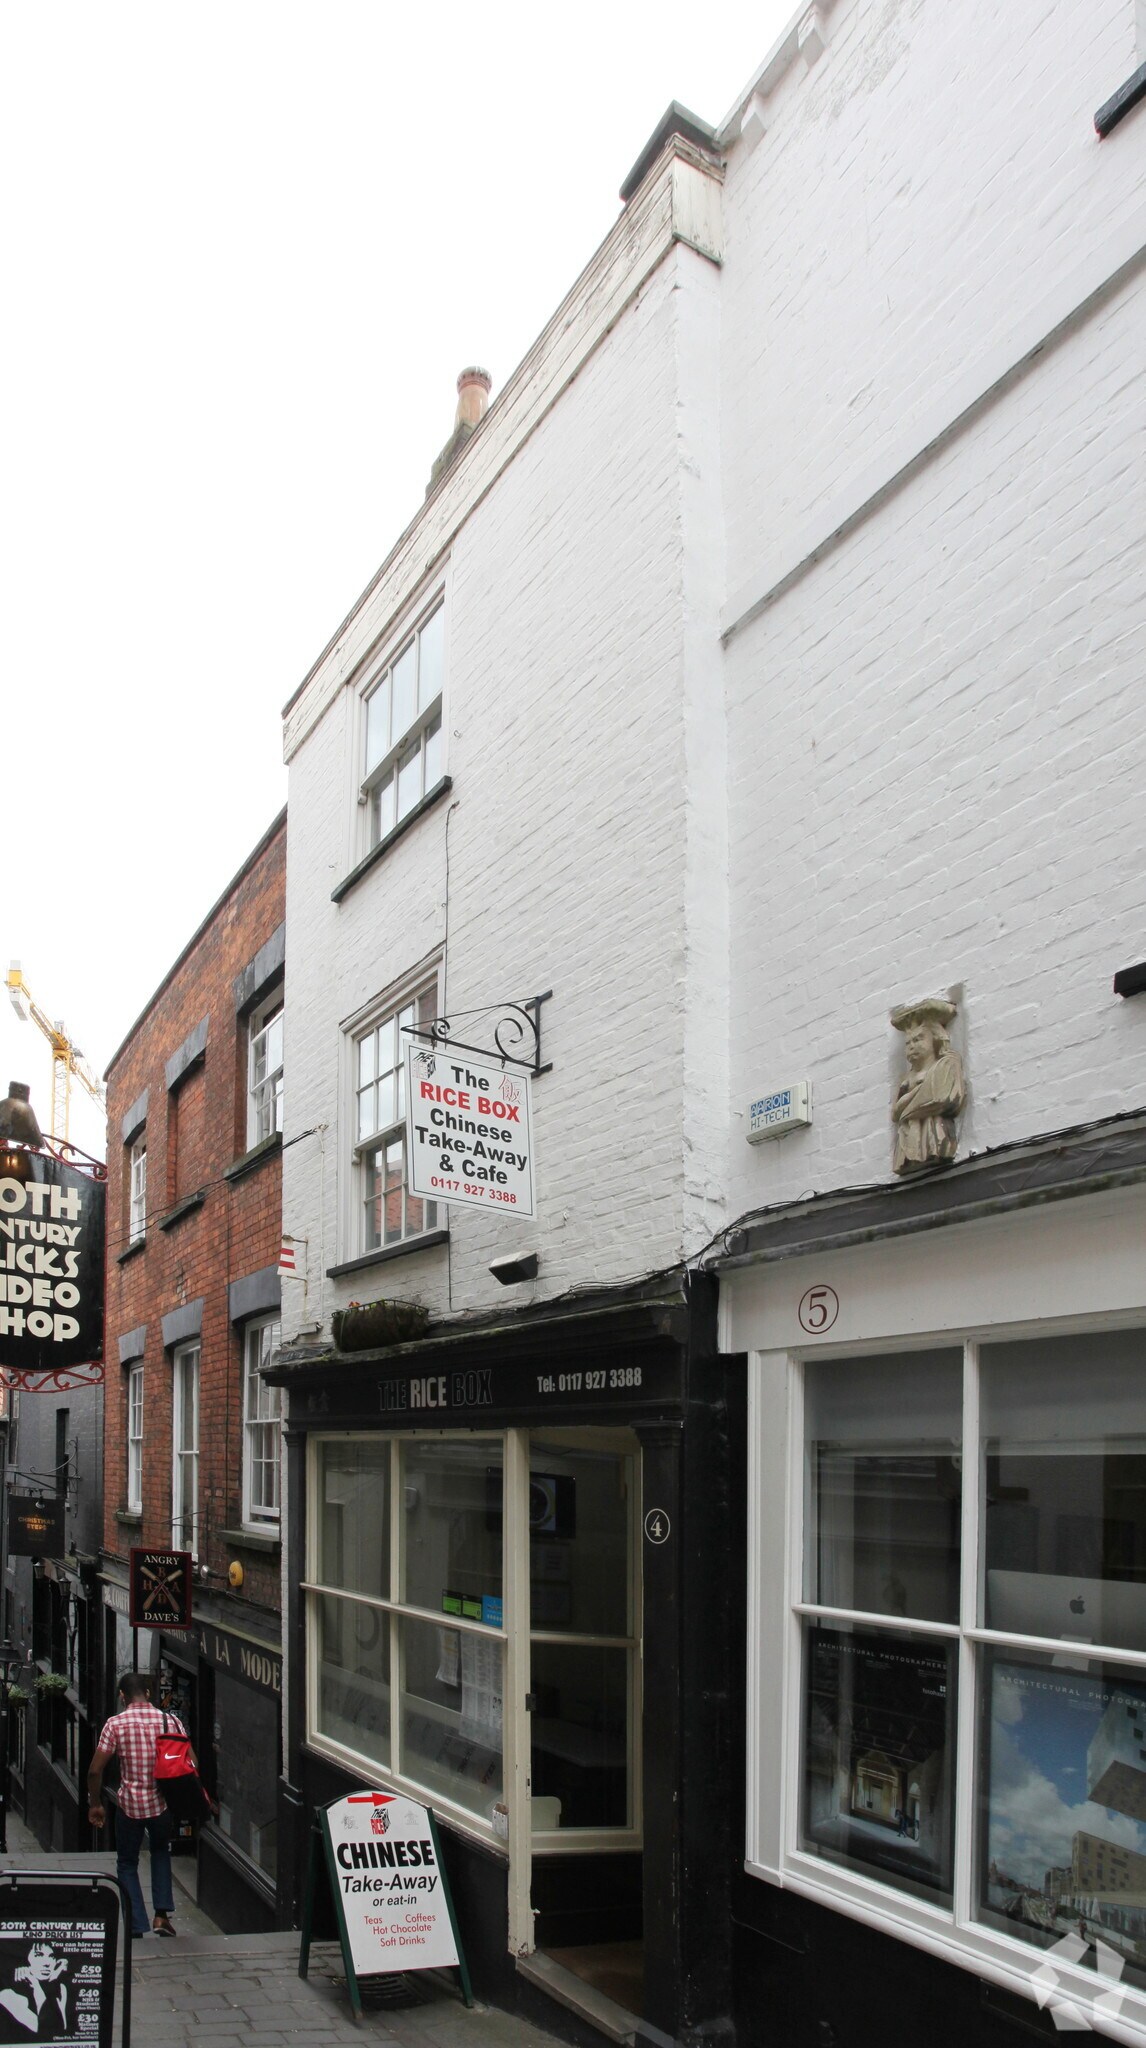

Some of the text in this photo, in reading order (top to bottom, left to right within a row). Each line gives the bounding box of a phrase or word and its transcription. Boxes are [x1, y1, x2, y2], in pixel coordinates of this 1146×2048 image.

[451, 1065, 490, 1091] The
[420, 1081, 520, 1123] RICE BOX
[430, 1108, 512, 1143] Chinese
[751, 1106, 790, 1130] HI-TECH
[415, 1125, 527, 1172] Take-Away
[439, 1153, 508, 1184] & Cafe
[431, 1176, 517, 1204] 0117 927 3388
[0, 1218, 82, 1246] NTURY
[0, 1274, 81, 1308] IDEO
[809, 1291, 828, 1328] 5
[0, 1306, 80, 1342] HOP
[378, 1369, 493, 1411] THE RICE BOX
[537, 1367, 642, 1393] Tel: 0117 927 3388
[650, 1515, 662, 1537] 4
[144, 1555, 180, 1565] ANGRY
[144, 1612, 179, 1622] DAVE'S
[216, 1635, 230, 1666] LA
[240, 1647, 281, 1692] MODE
[1001, 1676, 1081, 1696] ARCHITECTURAL
[336, 1840, 435, 1870] CHINESE
[342, 1873, 438, 1894] Take-Away
[372, 1894, 417, 1907] or eat-in
[30, 1922, 73, 1930] CENTURY
[76, 1922, 105, 1930] FLICKS
[364, 1913, 436, 1925] Teas Coffees
[373, 1924, 432, 1935] Hot Chocolate
[380, 1935, 426, 1947] Soft Drinks
[81, 1965, 101, 1974] £50
[79, 1989, 99, 1998] £40
[78, 2014, 98, 2023] £30
